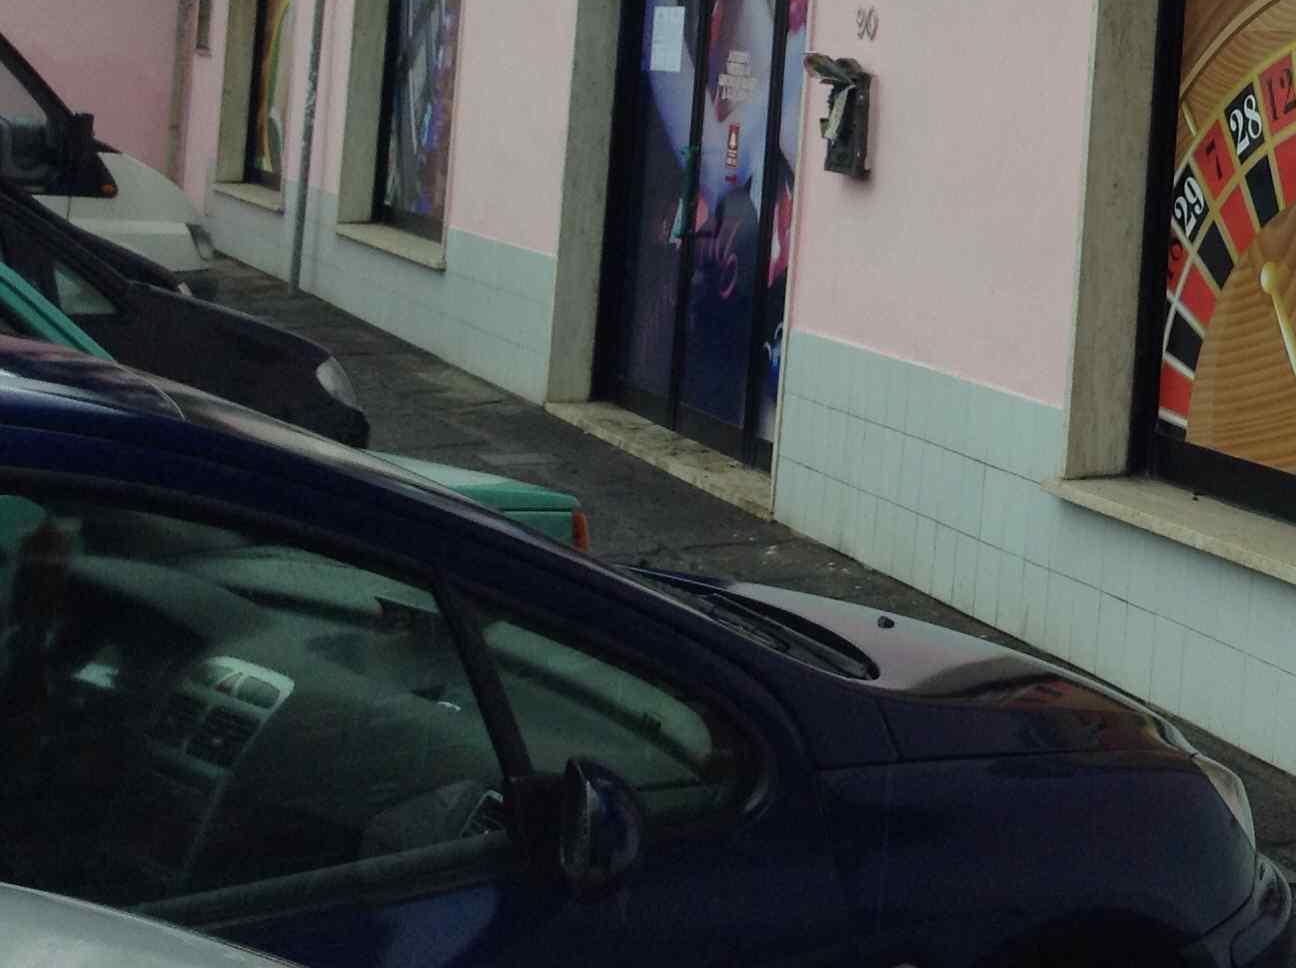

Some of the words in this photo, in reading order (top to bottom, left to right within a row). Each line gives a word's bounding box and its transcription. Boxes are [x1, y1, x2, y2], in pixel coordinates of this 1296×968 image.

[1266, 67, 1296, 121] 12
[1229, 94, 1262, 154] 28
[1205, 139, 1222, 180] 7
[1174, 176, 1204, 238] 29
